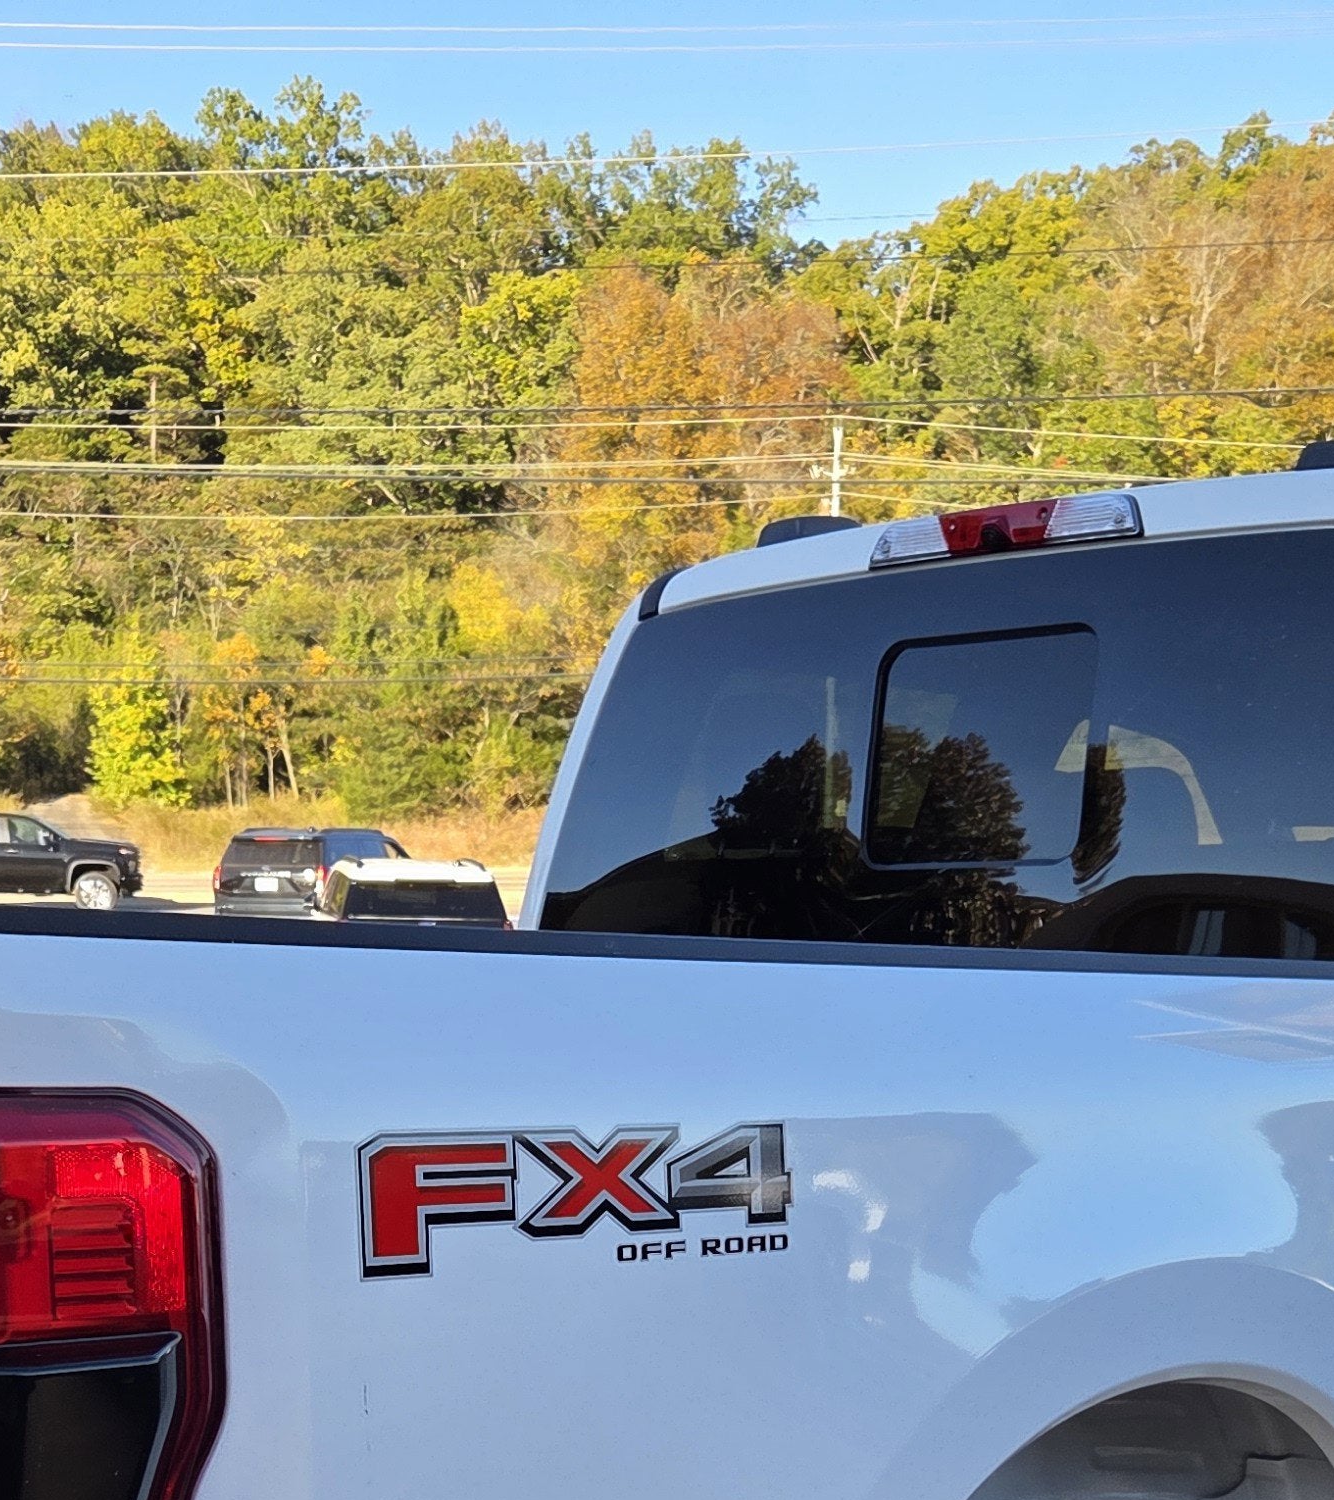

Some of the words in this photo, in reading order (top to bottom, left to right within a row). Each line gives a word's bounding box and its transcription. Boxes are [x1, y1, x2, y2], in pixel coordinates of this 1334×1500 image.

[356, 1121, 793, 1281] FX4
[616, 1243, 686, 1263] OFF
[700, 1233, 789, 1257] ROAD
